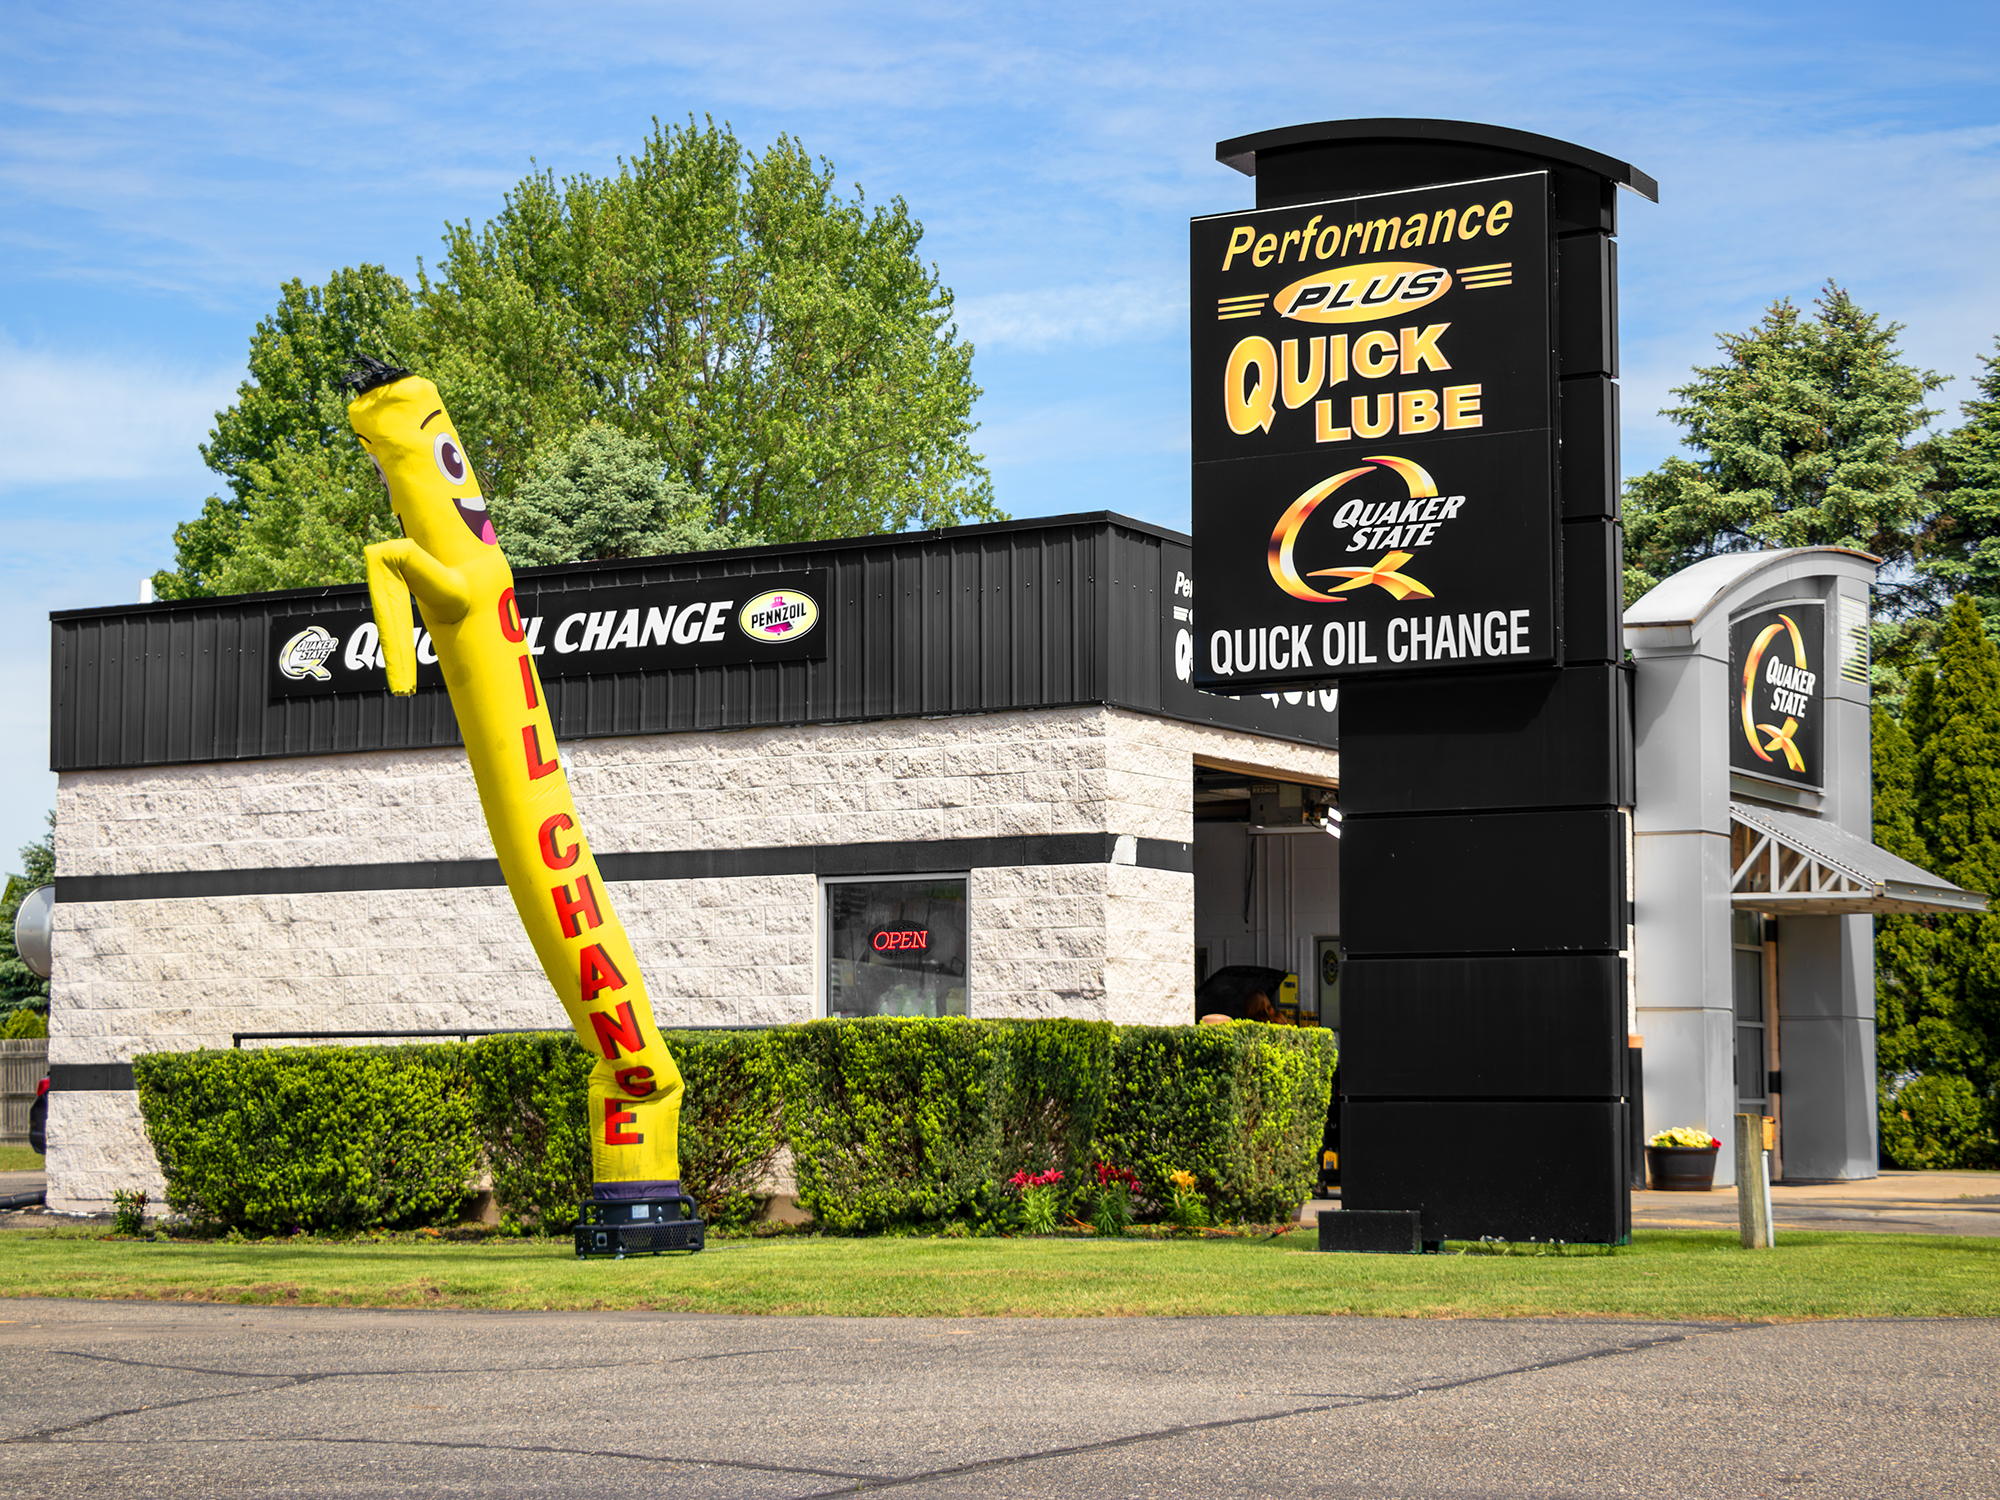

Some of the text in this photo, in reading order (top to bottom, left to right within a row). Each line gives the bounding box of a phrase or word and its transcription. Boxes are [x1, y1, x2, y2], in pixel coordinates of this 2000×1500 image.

[1222, 200, 1514, 272] Performance
[1281, 268, 1449, 318] PLUS
[1224, 322, 1452, 435] QUICK
[1315, 383, 1484, 443] LUBE
[1333, 495, 1466, 529] QUAKER
[1345, 522, 1442, 552] STATE
[554, 600, 734, 654] CHANGE
[751, 602, 807, 629] PENNZOIL
[296, 639, 337, 652] QUAKER
[299, 649, 328, 661] STATE
[1210, 609, 1531, 677] QUICK OIL CHANGE
[1766, 655, 1816, 696] QUAKER
[1770, 687, 1808, 718] STATE
[498, 587, 657, 1145] OIL CHANGE
[873, 930, 928, 951] OPEN
